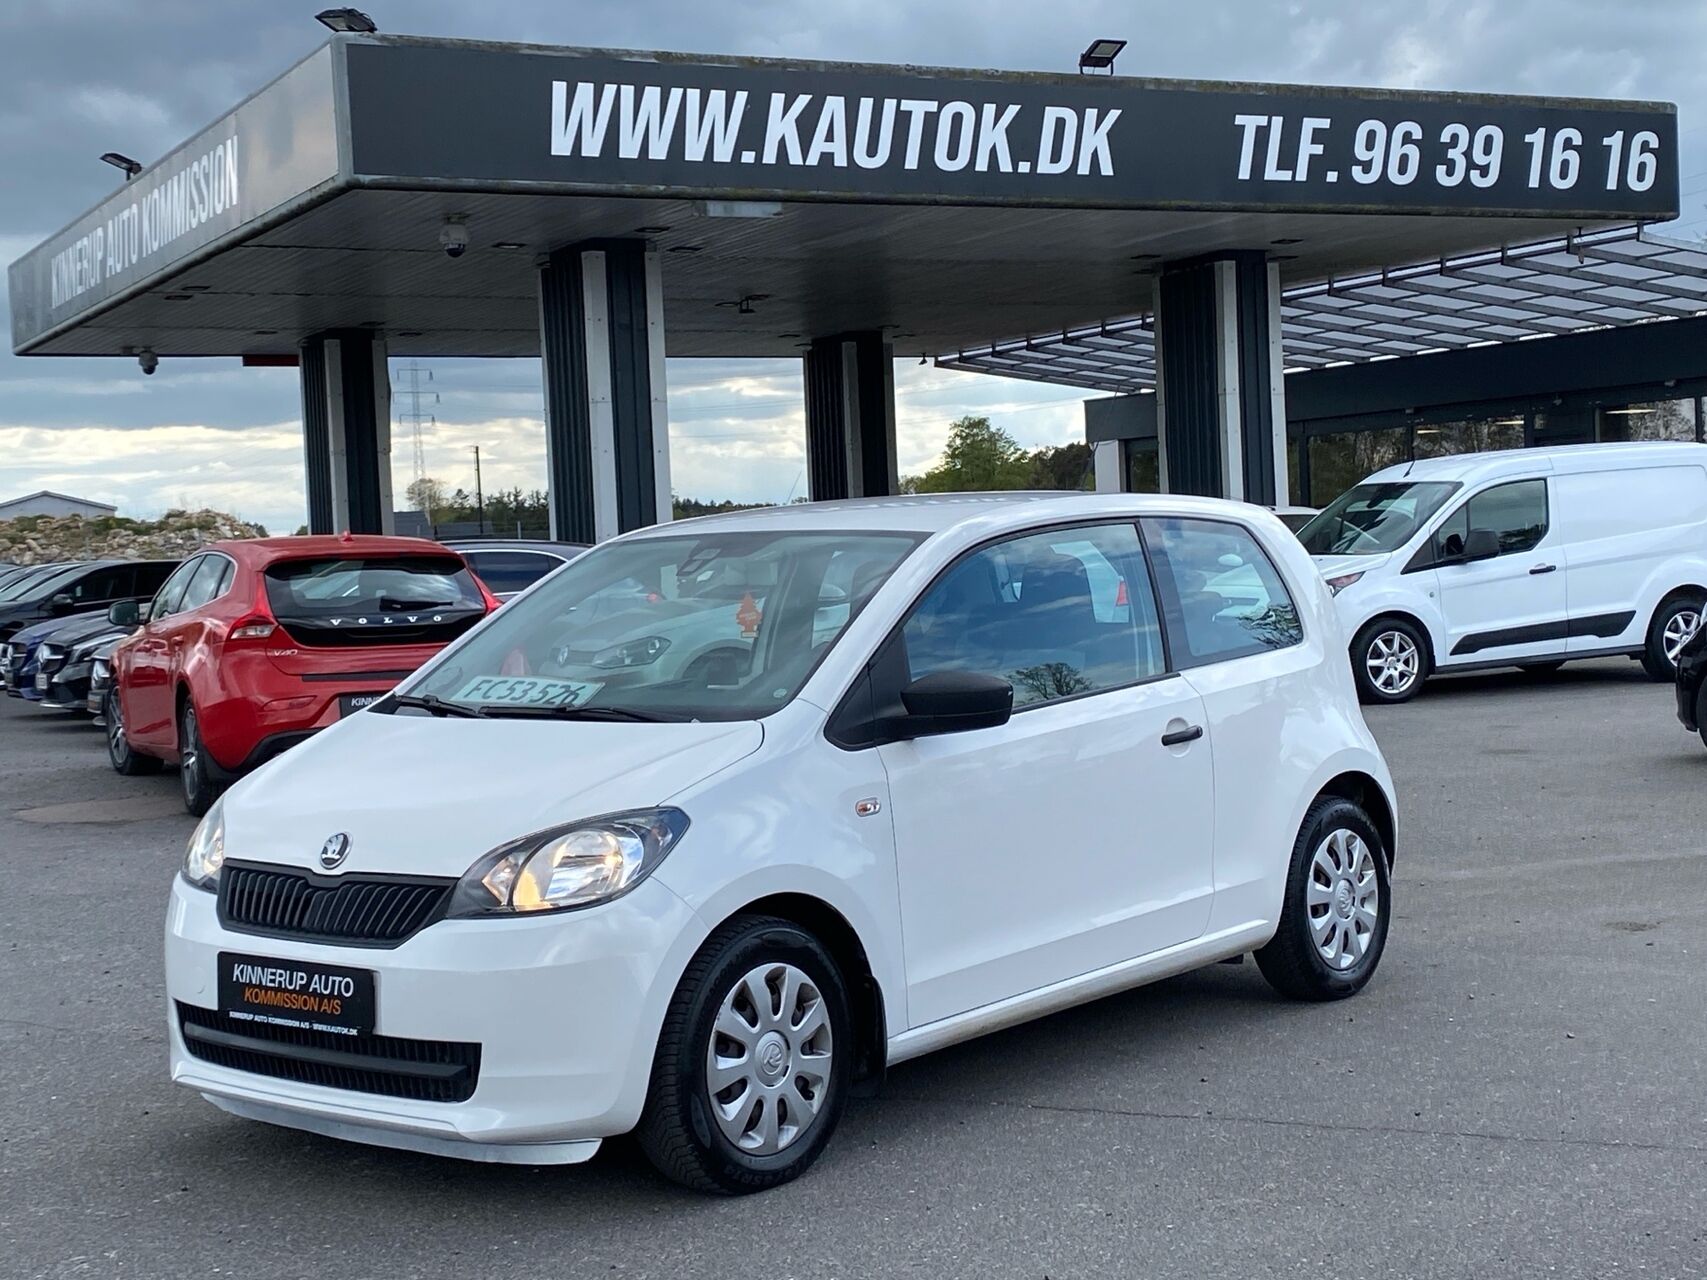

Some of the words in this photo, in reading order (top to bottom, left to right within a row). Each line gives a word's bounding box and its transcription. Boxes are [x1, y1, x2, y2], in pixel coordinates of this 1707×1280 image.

[551, 80, 1122, 176] WWW.KAUTOK.DK
[1234, 114, 1338, 183] TLF.
[1351, 119, 1423, 185] 96
[1435, 123, 1504, 188] 39
[1524, 127, 1583, 190] 16
[1602, 130, 1660, 191] 16
[51, 226, 105, 309] KINNERUP
[106, 203, 139, 278] AUTO
[142, 135, 238, 258] KOMMISSION
[330, 614, 442, 627] VOLVO
[232, 963, 308, 990] KINNERUP
[309, 974, 354, 998] AUTO
[244, 986, 319, 1012] KOMMISSION
[321, 1000, 342, 1016] A/S
